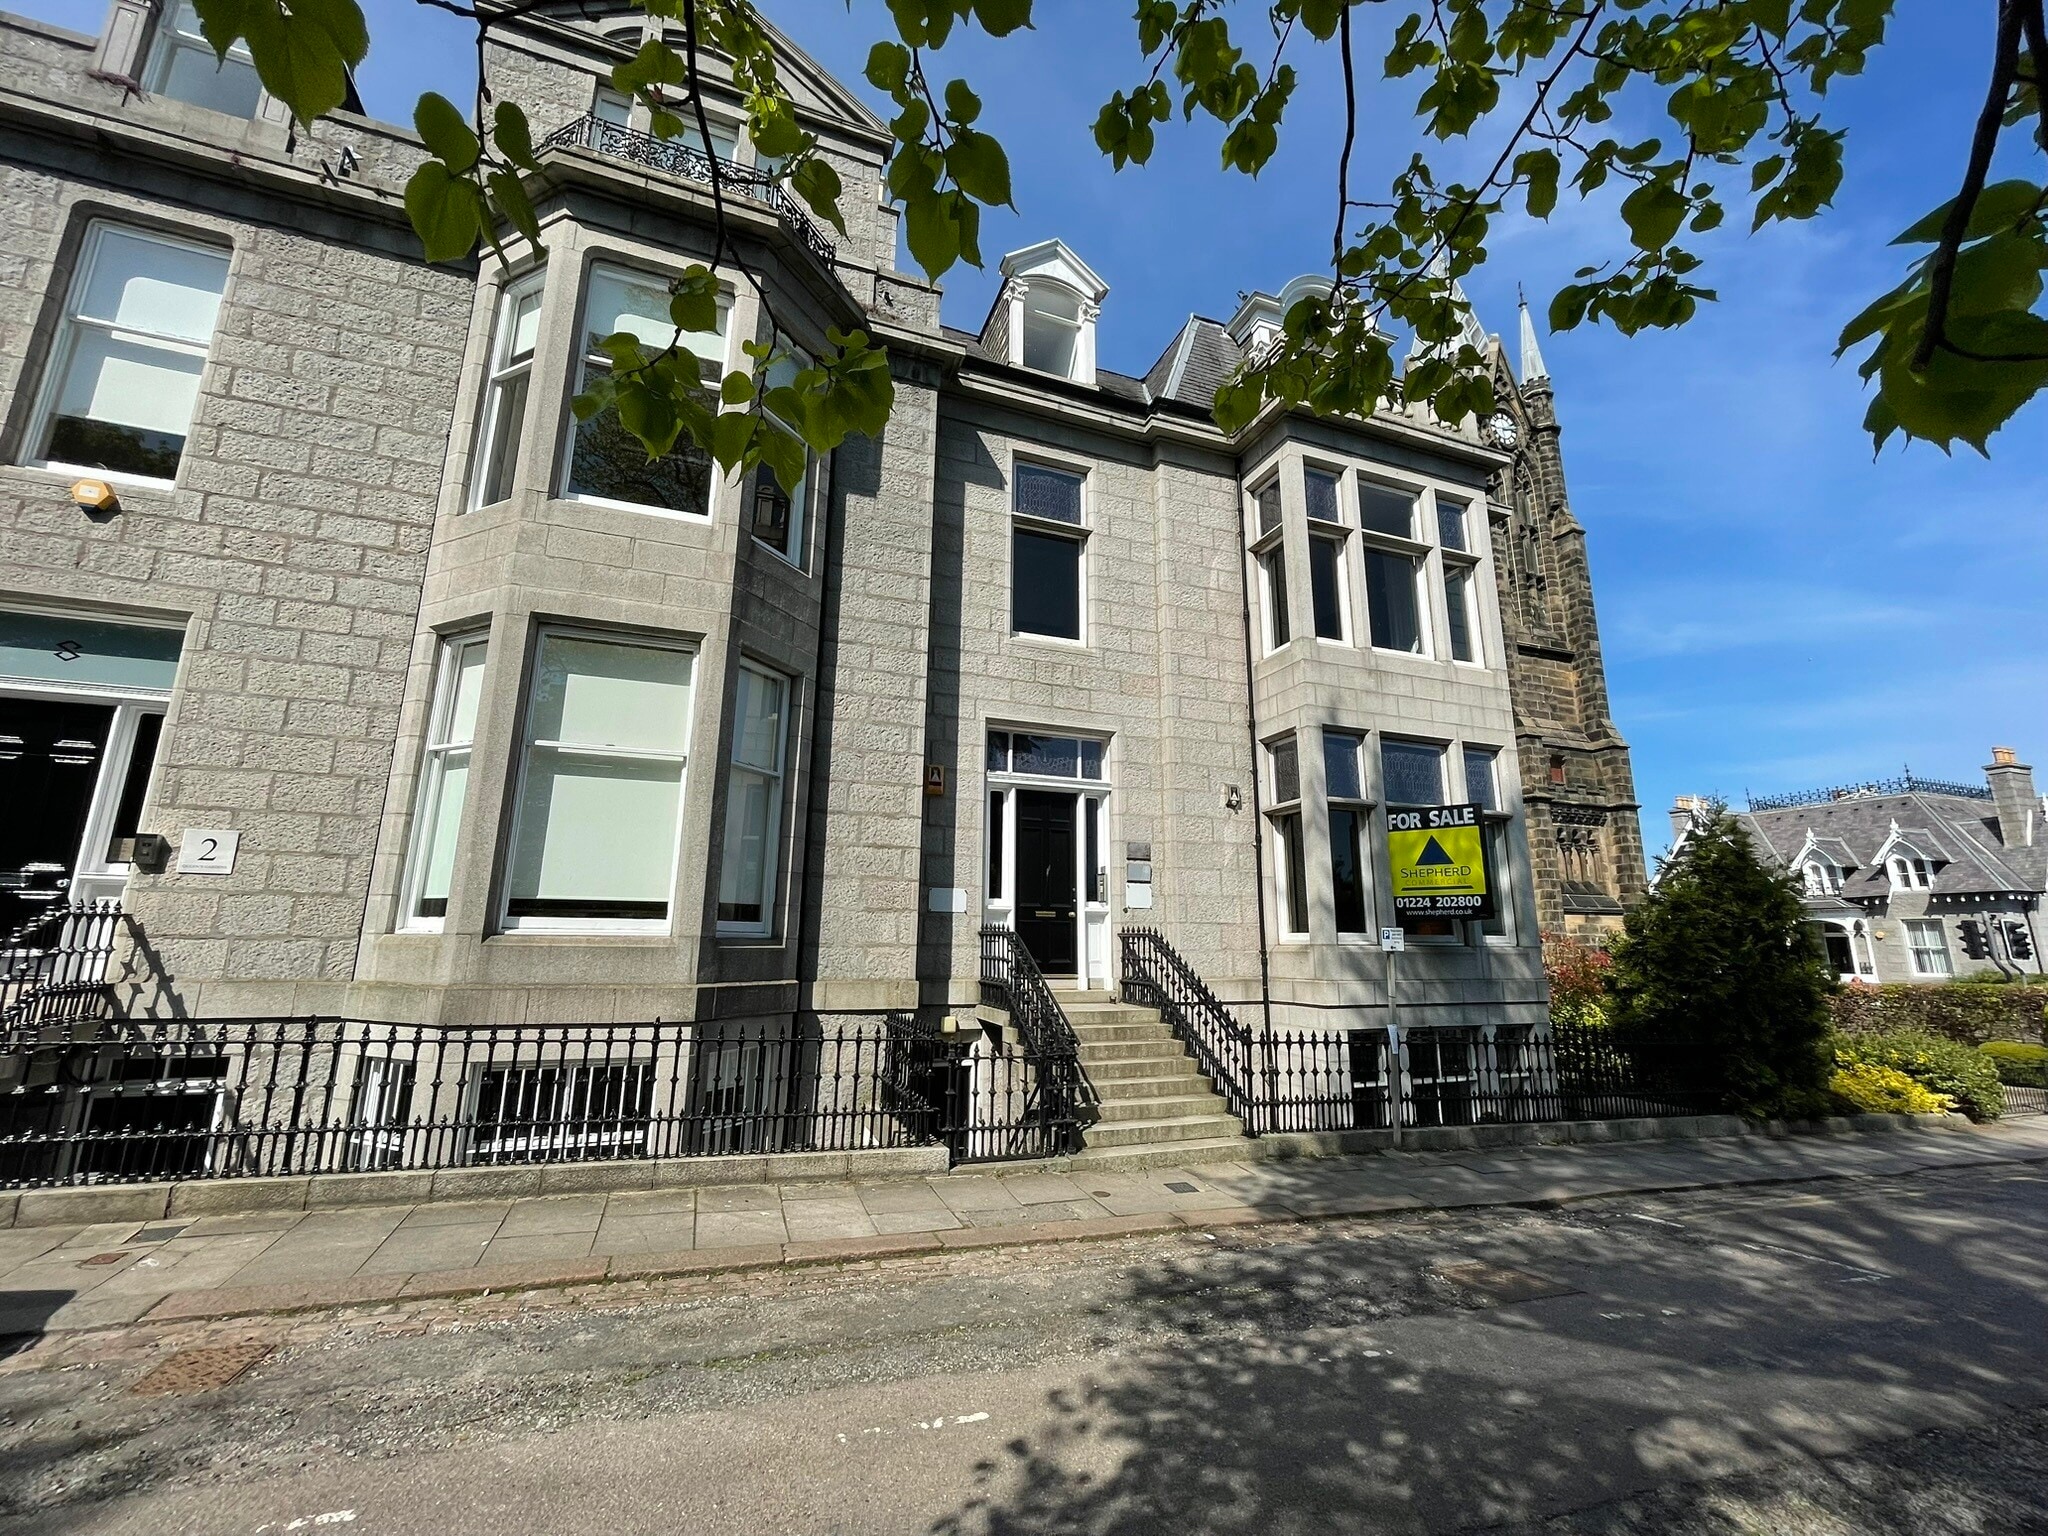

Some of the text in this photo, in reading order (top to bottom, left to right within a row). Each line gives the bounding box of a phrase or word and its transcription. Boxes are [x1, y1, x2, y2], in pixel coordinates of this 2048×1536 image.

[1388, 808, 1475, 830] FOR SALE
[197, 838, 217, 861] 2
[1400, 865, 1472, 879] SHEPHERD
[1405, 878, 1469, 887] COMMERCIAL
[1396, 895, 1482, 908] 01224 202800
[1406, 908, 1473, 916] www.shepherd.co.uk
